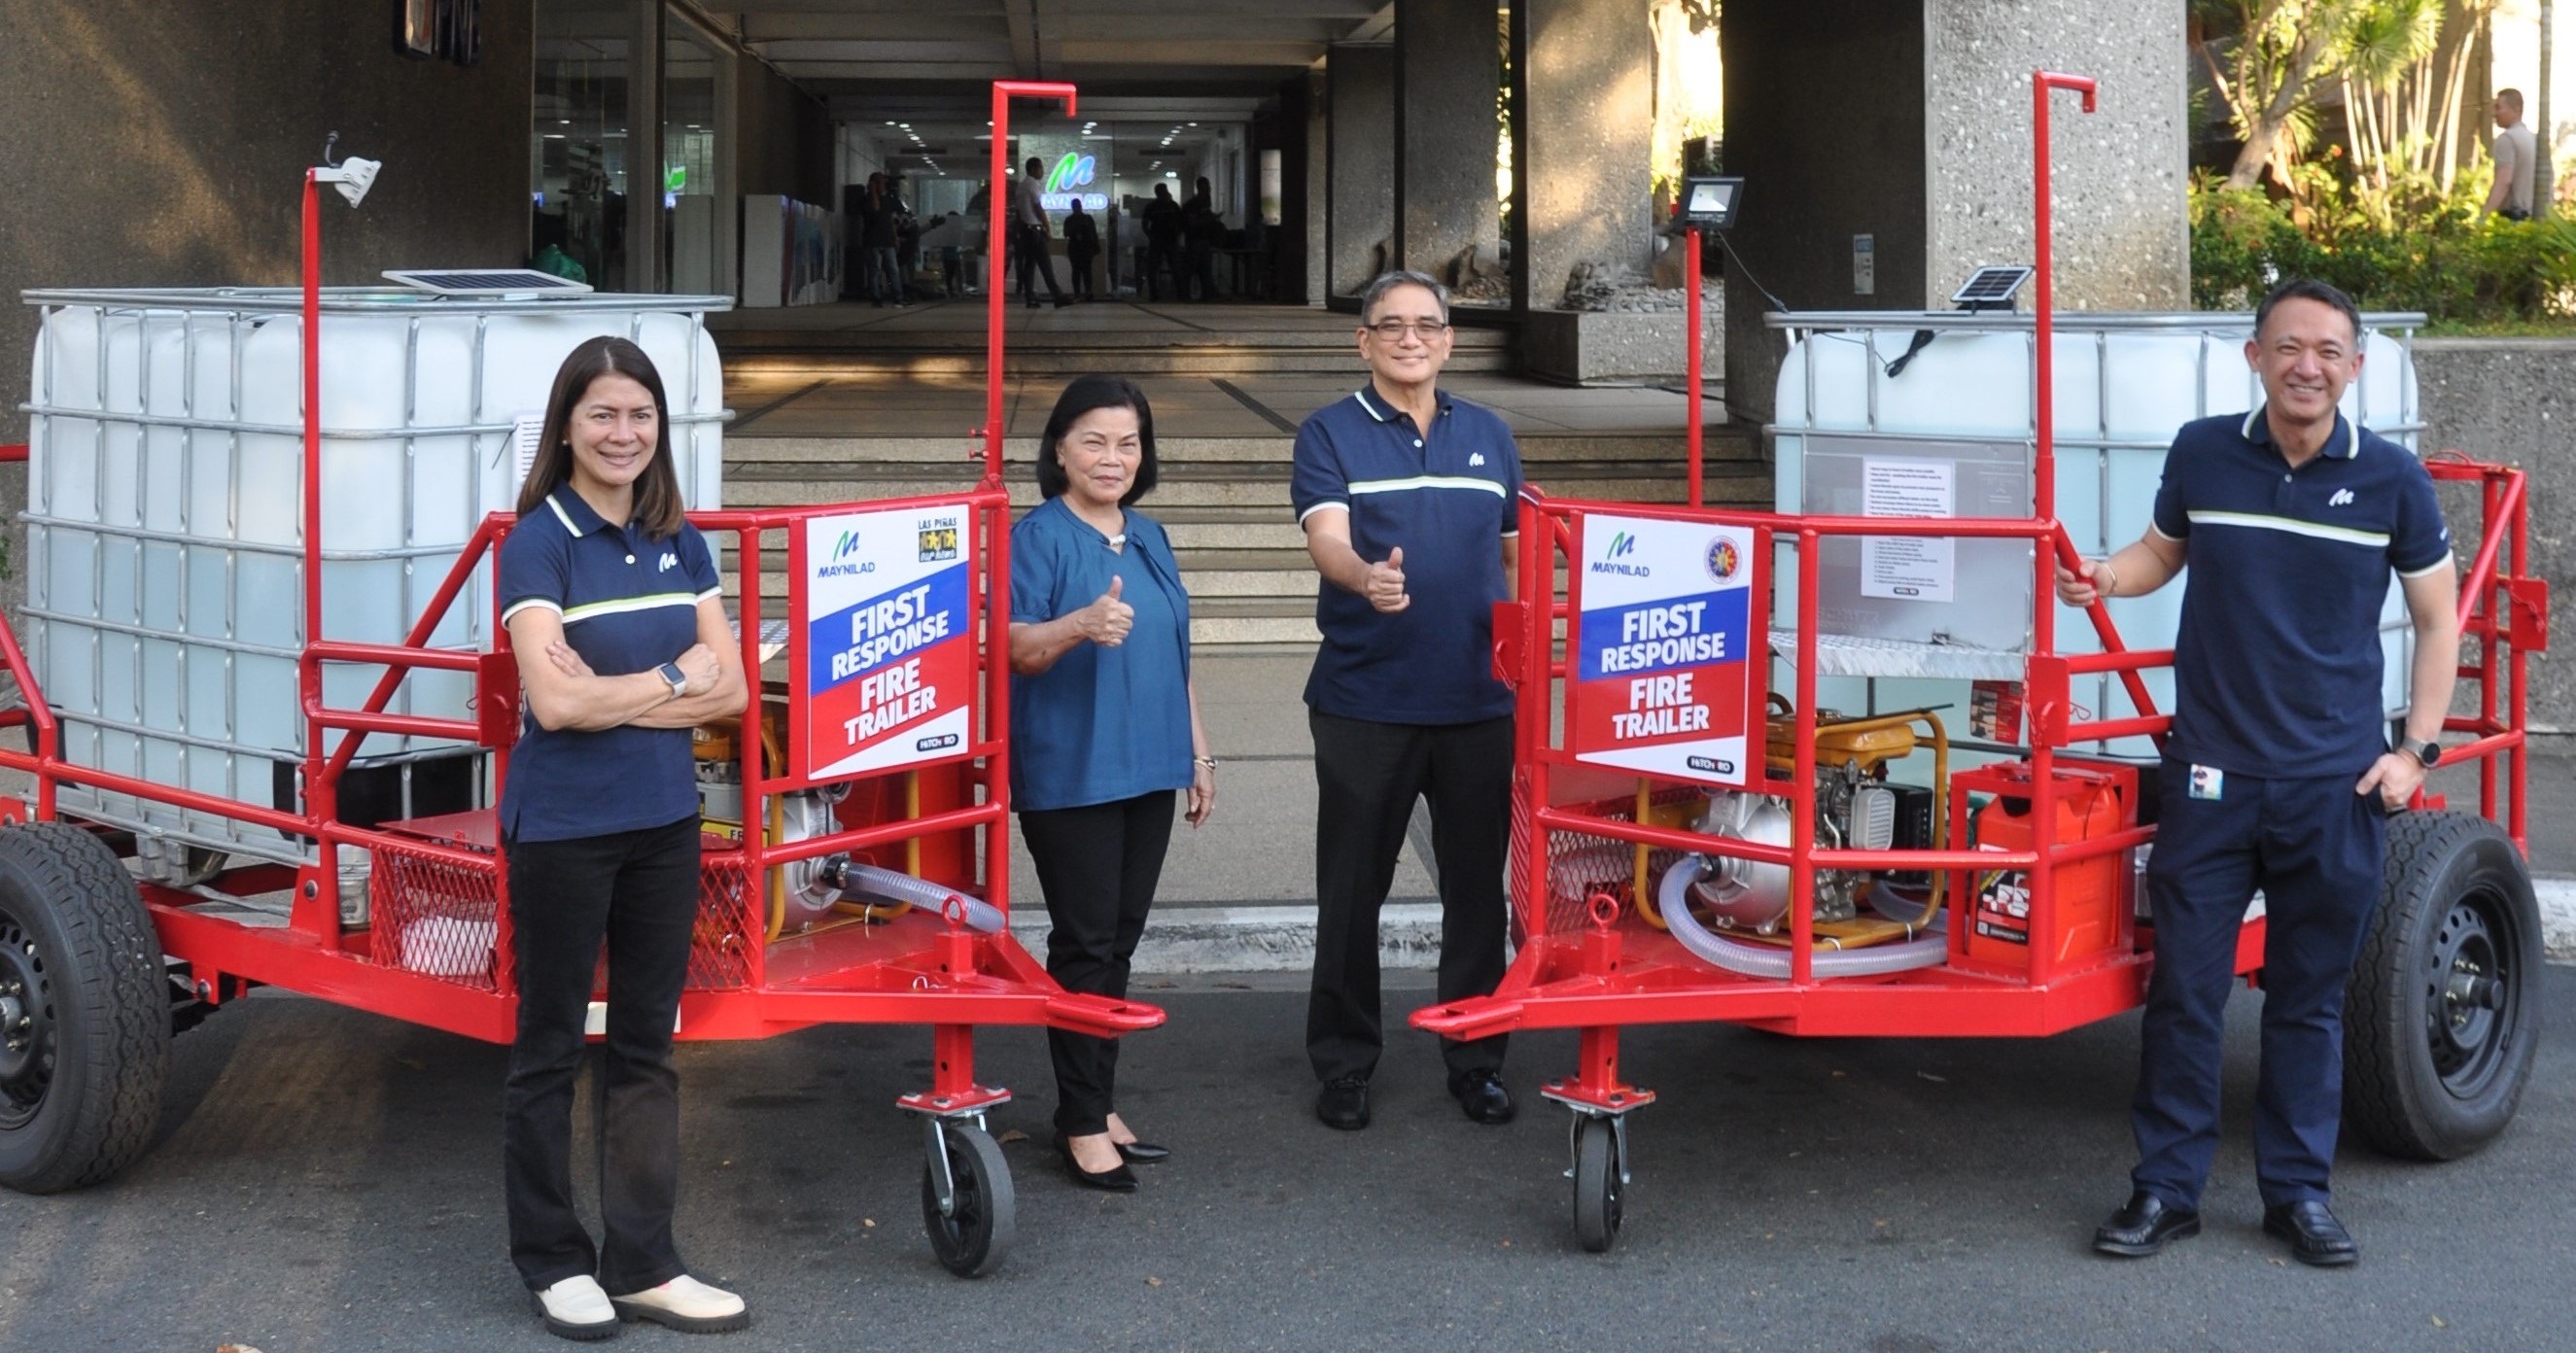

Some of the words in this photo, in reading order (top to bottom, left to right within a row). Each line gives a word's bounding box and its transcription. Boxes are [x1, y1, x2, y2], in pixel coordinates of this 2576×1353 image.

[818, 562, 875, 577] MAYNILAD
[1591, 562, 1650, 577] MAYNILAD
[852, 583, 930, 644] FIRST
[1622, 601, 1707, 643] FIRST
[831, 610, 949, 681] RESPONSE
[1601, 632, 1725, 674] RESPONSE
[860, 657, 921, 712] FIRE
[1629, 672, 1693, 711] FIRE
[844, 685, 937, 746] TRAILER
[1612, 705, 1710, 740] TRAILER
